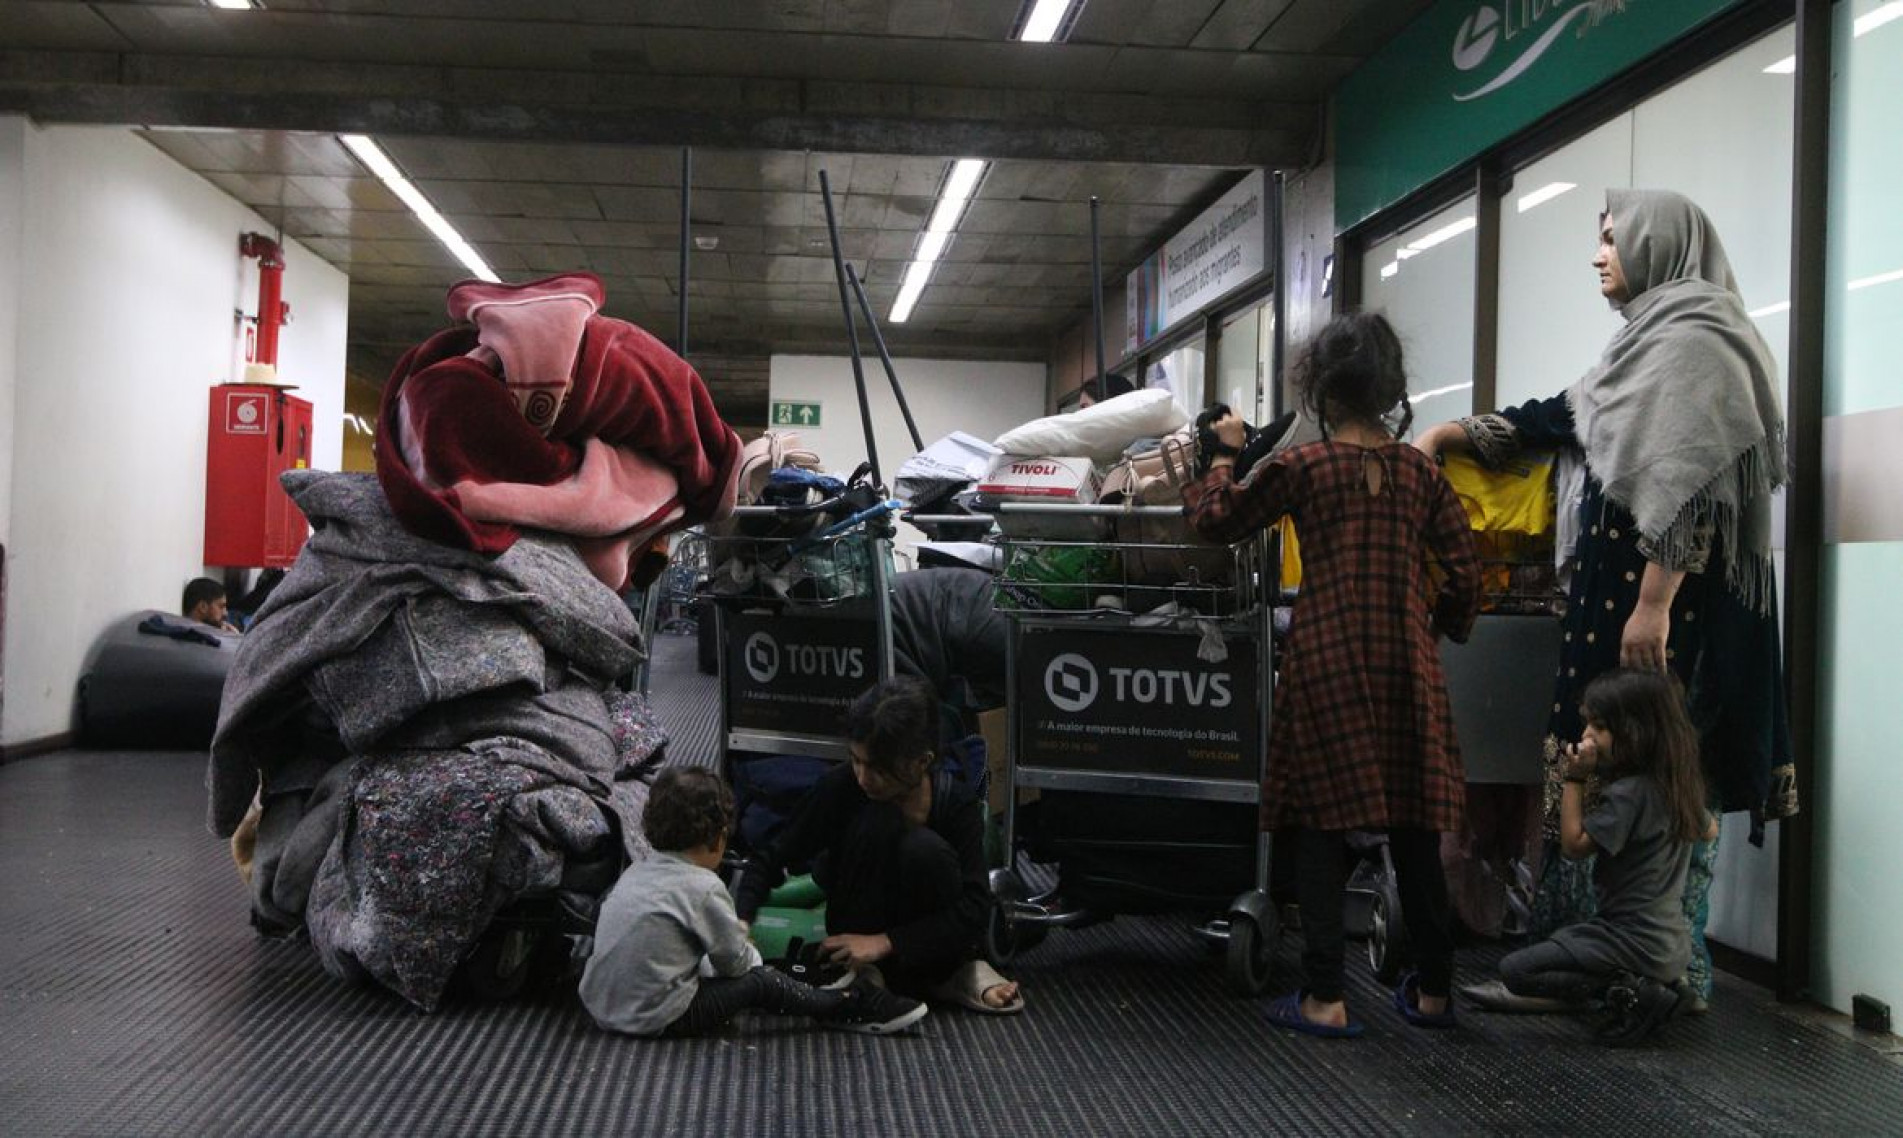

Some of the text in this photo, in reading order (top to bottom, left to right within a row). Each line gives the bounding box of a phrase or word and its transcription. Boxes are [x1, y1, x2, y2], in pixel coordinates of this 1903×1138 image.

[1011, 464, 1057, 476] TIVOLI
[784, 644, 864, 678] TOTVS
[1109, 667, 1233, 708] TOTVS
[1057, 721, 1083, 731] maior
[1086, 724, 1127, 736] empresa
[1129, 725, 1140, 736] de
[1142, 727, 1192, 740] tecnologia
[1194, 729, 1207, 739] do
